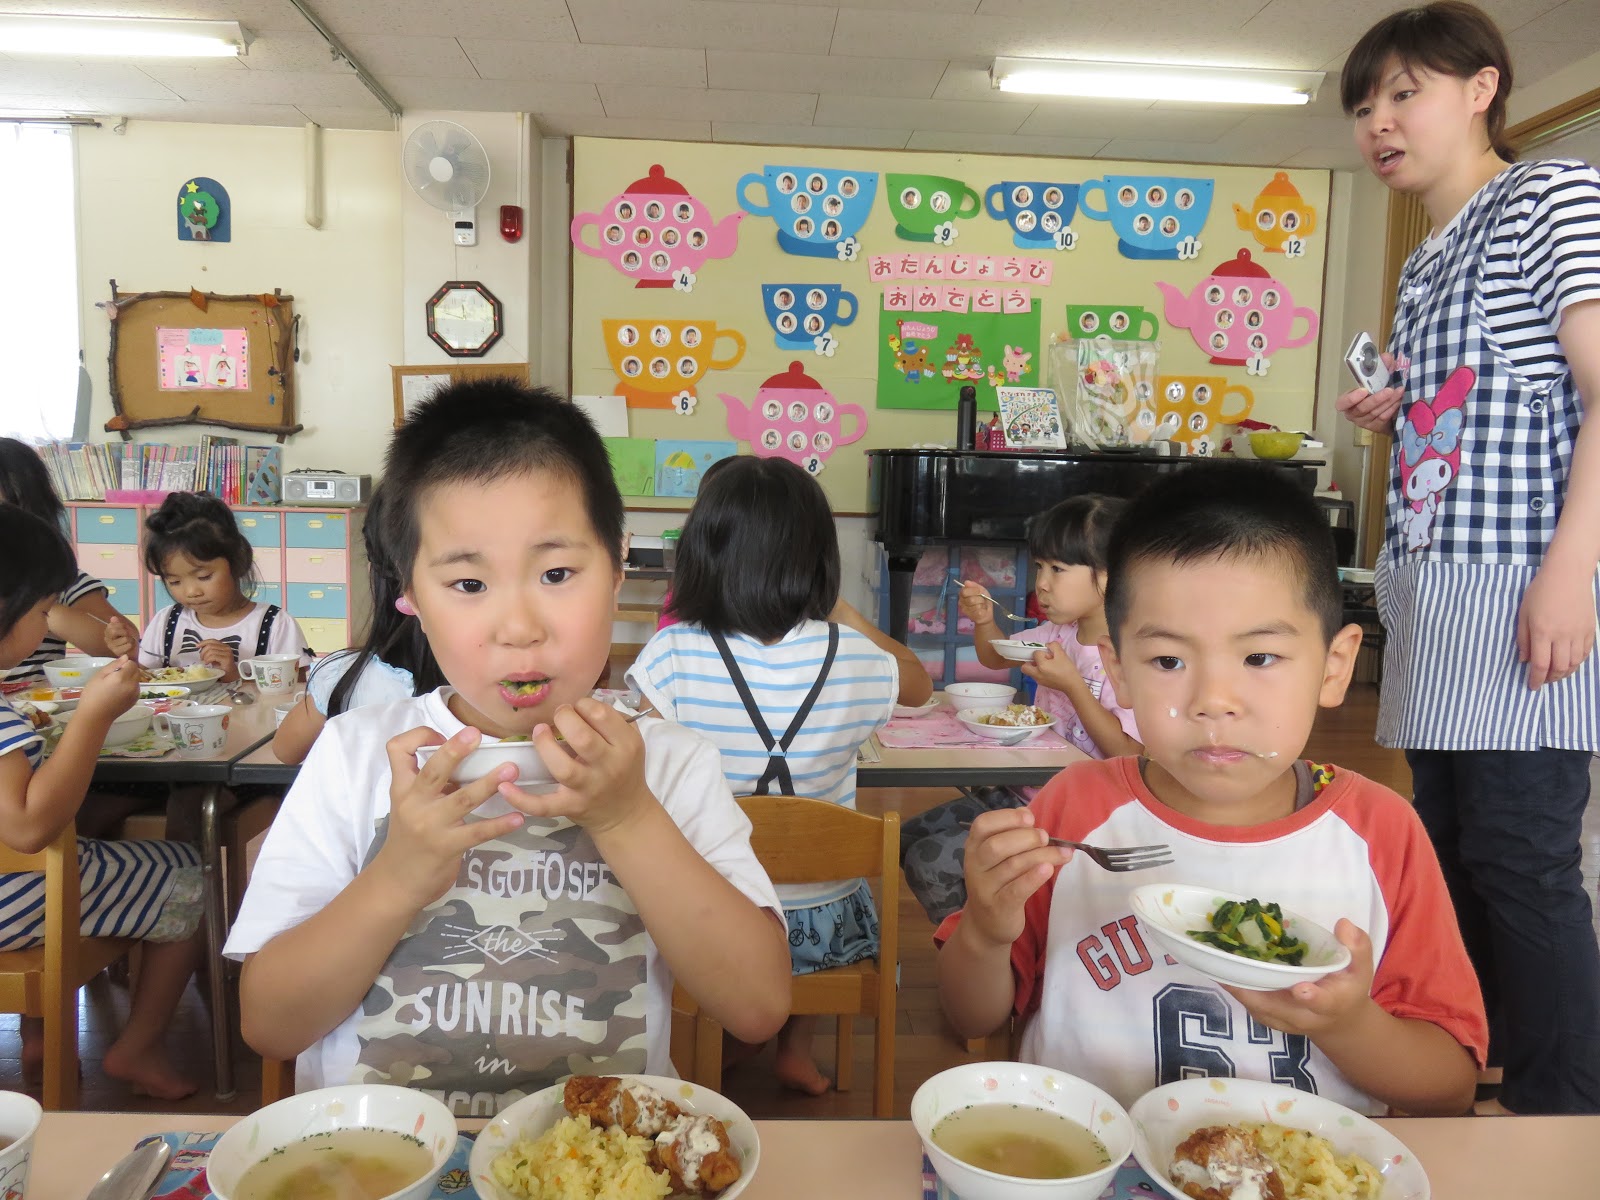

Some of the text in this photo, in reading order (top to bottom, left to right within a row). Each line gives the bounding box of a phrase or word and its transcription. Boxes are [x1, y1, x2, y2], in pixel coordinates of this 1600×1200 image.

[941, 227, 951, 241] 9
[1060, 233, 1073, 246] 10
[844, 243, 854, 257] 5
[1183, 242, 1195, 255] 11
[1288, 240, 1301, 254] 12
[873, 258, 1048, 280] おたんじょうび
[679, 273, 689, 287] 4
[889, 290, 1026, 308] おめでとう
[822, 337, 831, 352] 7
[1256, 358, 1261, 371] 1
[680, 396, 689, 411] 6
[1198, 441, 1208, 455] 3
[808, 458, 818, 473] 8
[484, 927, 527, 952] the
[411, 981, 585, 1038] SUNRISE
[474, 1043, 517, 1076] in
